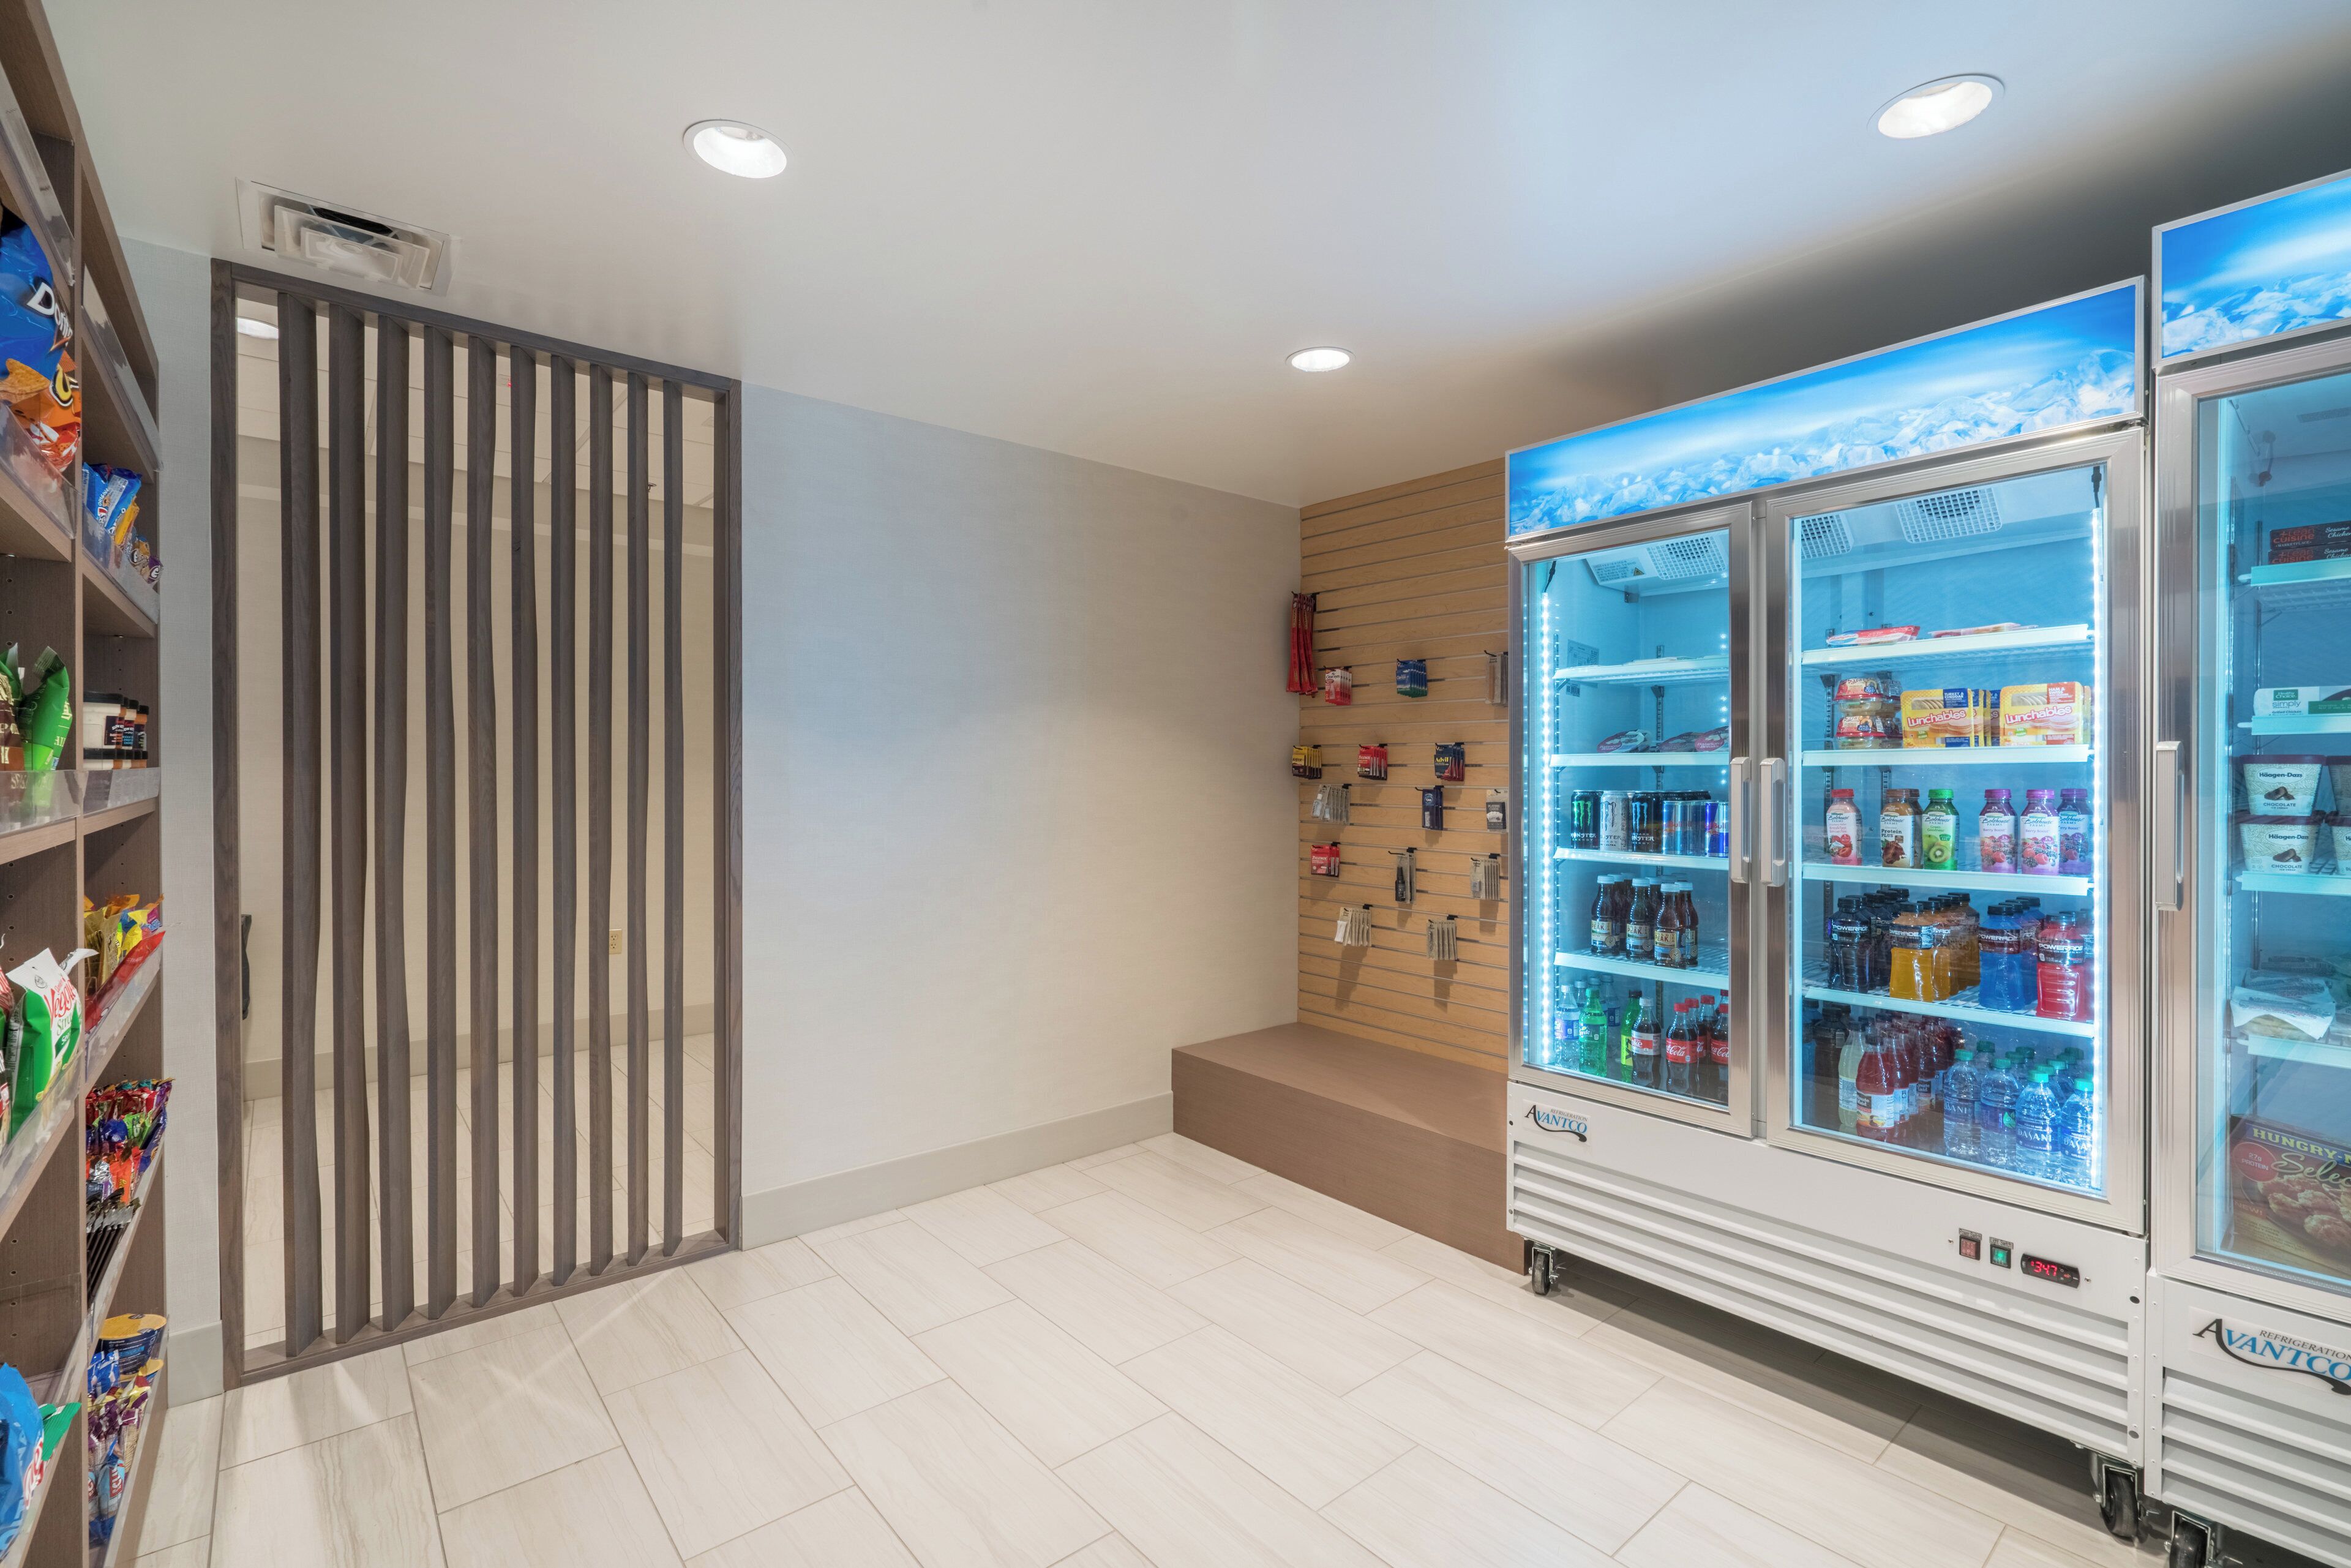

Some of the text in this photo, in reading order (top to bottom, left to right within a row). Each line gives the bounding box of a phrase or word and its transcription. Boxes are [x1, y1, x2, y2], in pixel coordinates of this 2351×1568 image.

[98, 488, 109, 506] ORIGINA
[1907, 710, 1966, 727] Lunchables
[2004, 705, 2072, 725] Lunchables
[1524, 1105, 1588, 1137] AVANTCO
[1550, 1109, 1588, 1122] REFRIGERATION
[2017, 1128, 2052, 1142] DASANI
[2241, 1158, 2269, 1171] PROTEIN
[2249, 1153, 2262, 1162] 27g
[2235, 1202, 2263, 1216] NEW!
[2192, 1318, 2351, 1387] AVANTCO
